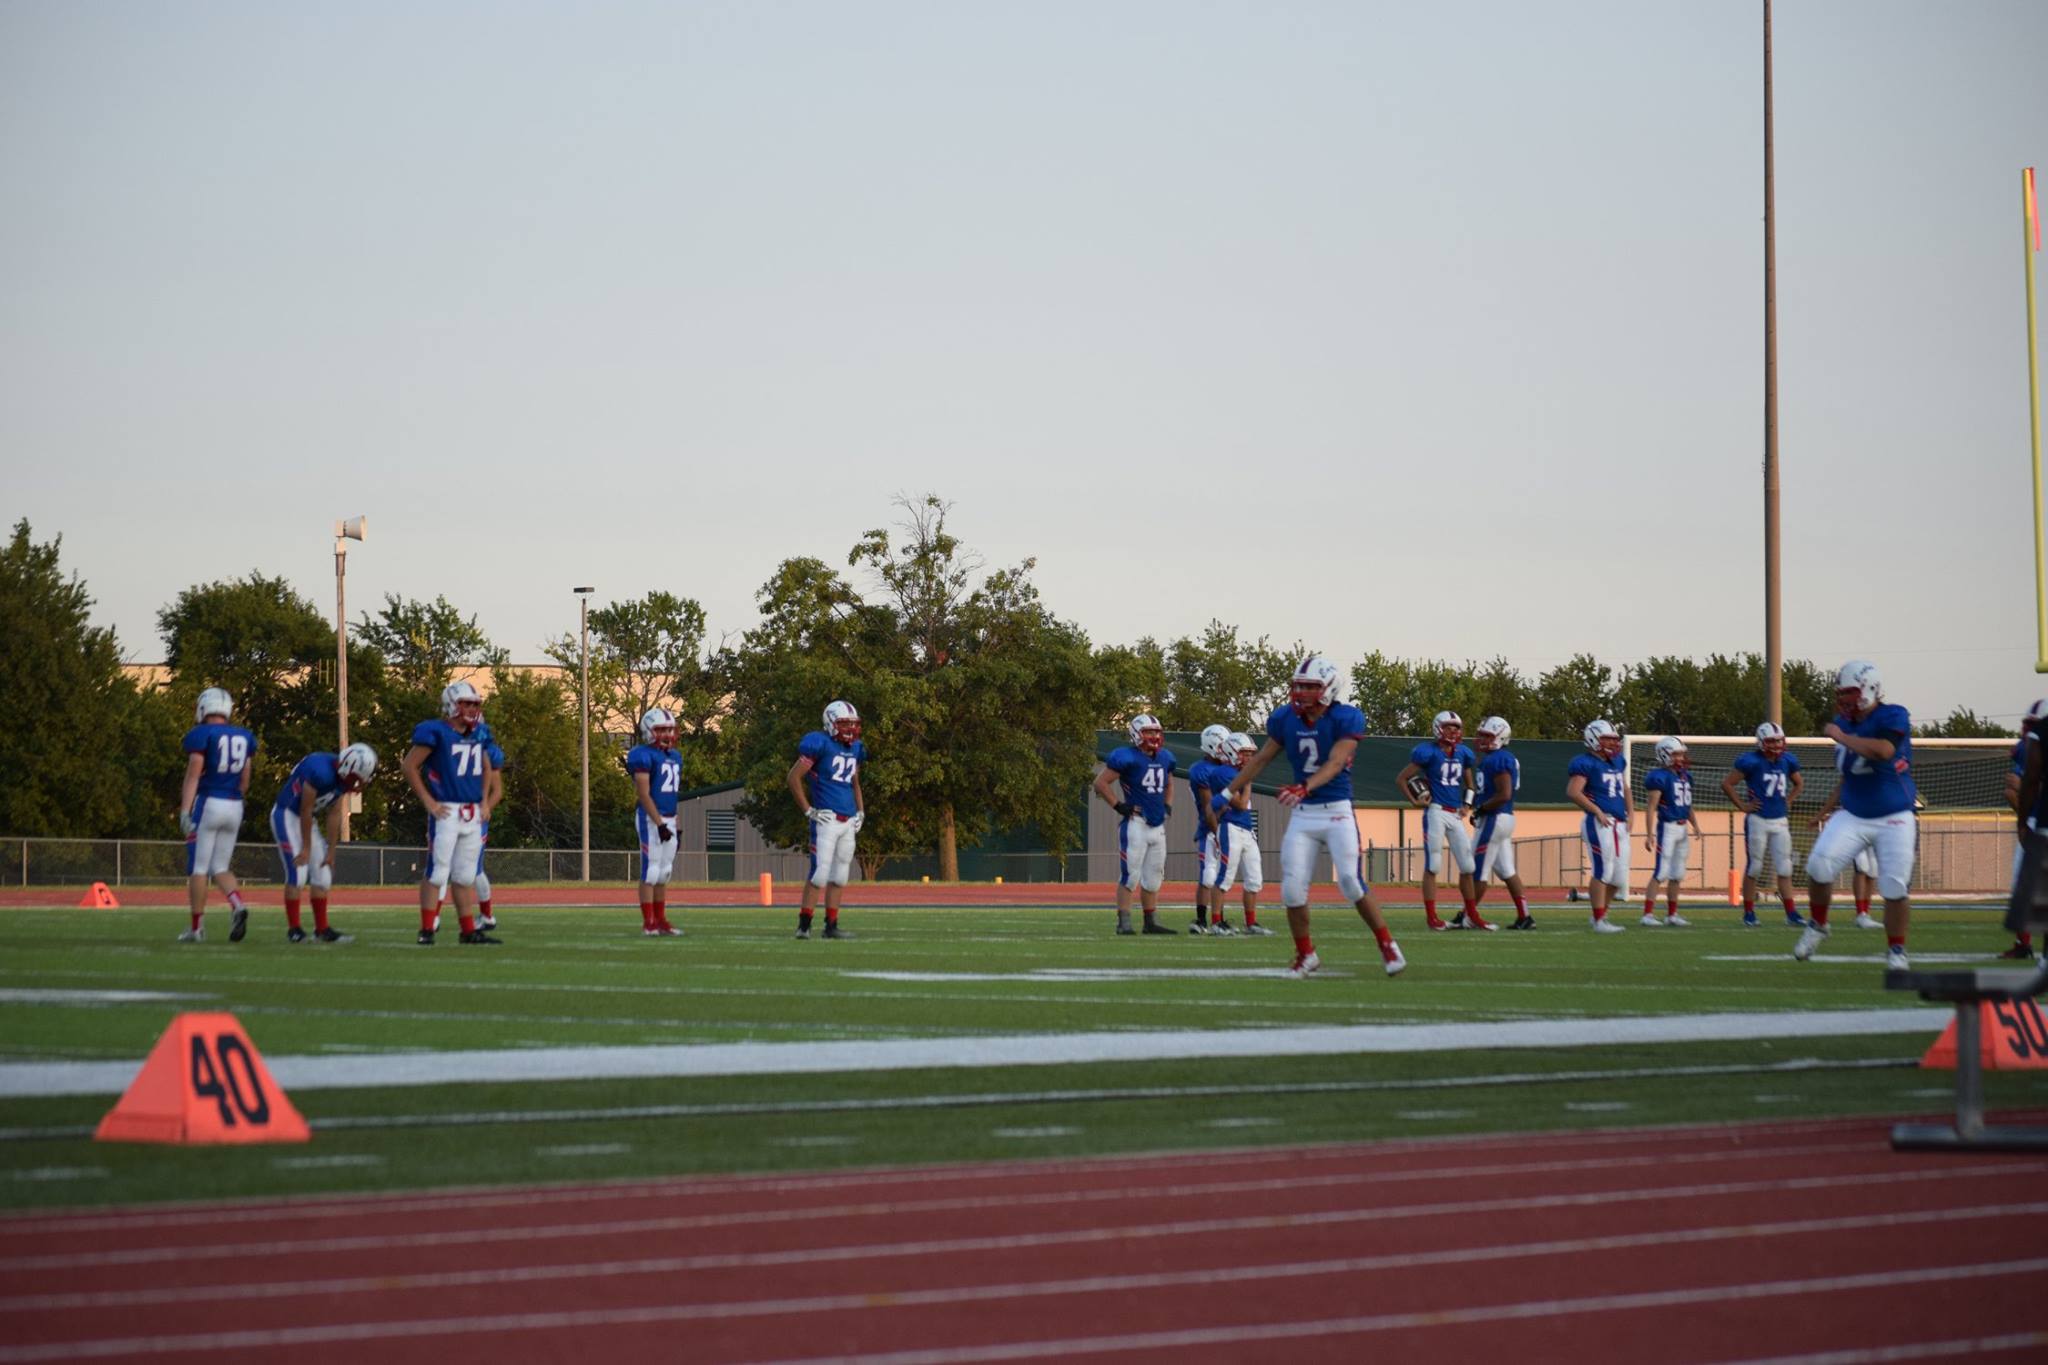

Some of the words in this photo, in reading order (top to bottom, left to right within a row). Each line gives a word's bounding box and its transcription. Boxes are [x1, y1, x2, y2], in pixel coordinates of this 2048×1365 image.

[217, 735, 248, 773] 19
[452, 744, 482, 776] 71
[1299, 738, 1322, 773] 2
[1142, 768, 1165, 793] 41
[1440, 762, 1462, 786] 12
[1992, 997, 2048, 1057] 50
[191, 1034, 270, 1127] 40
